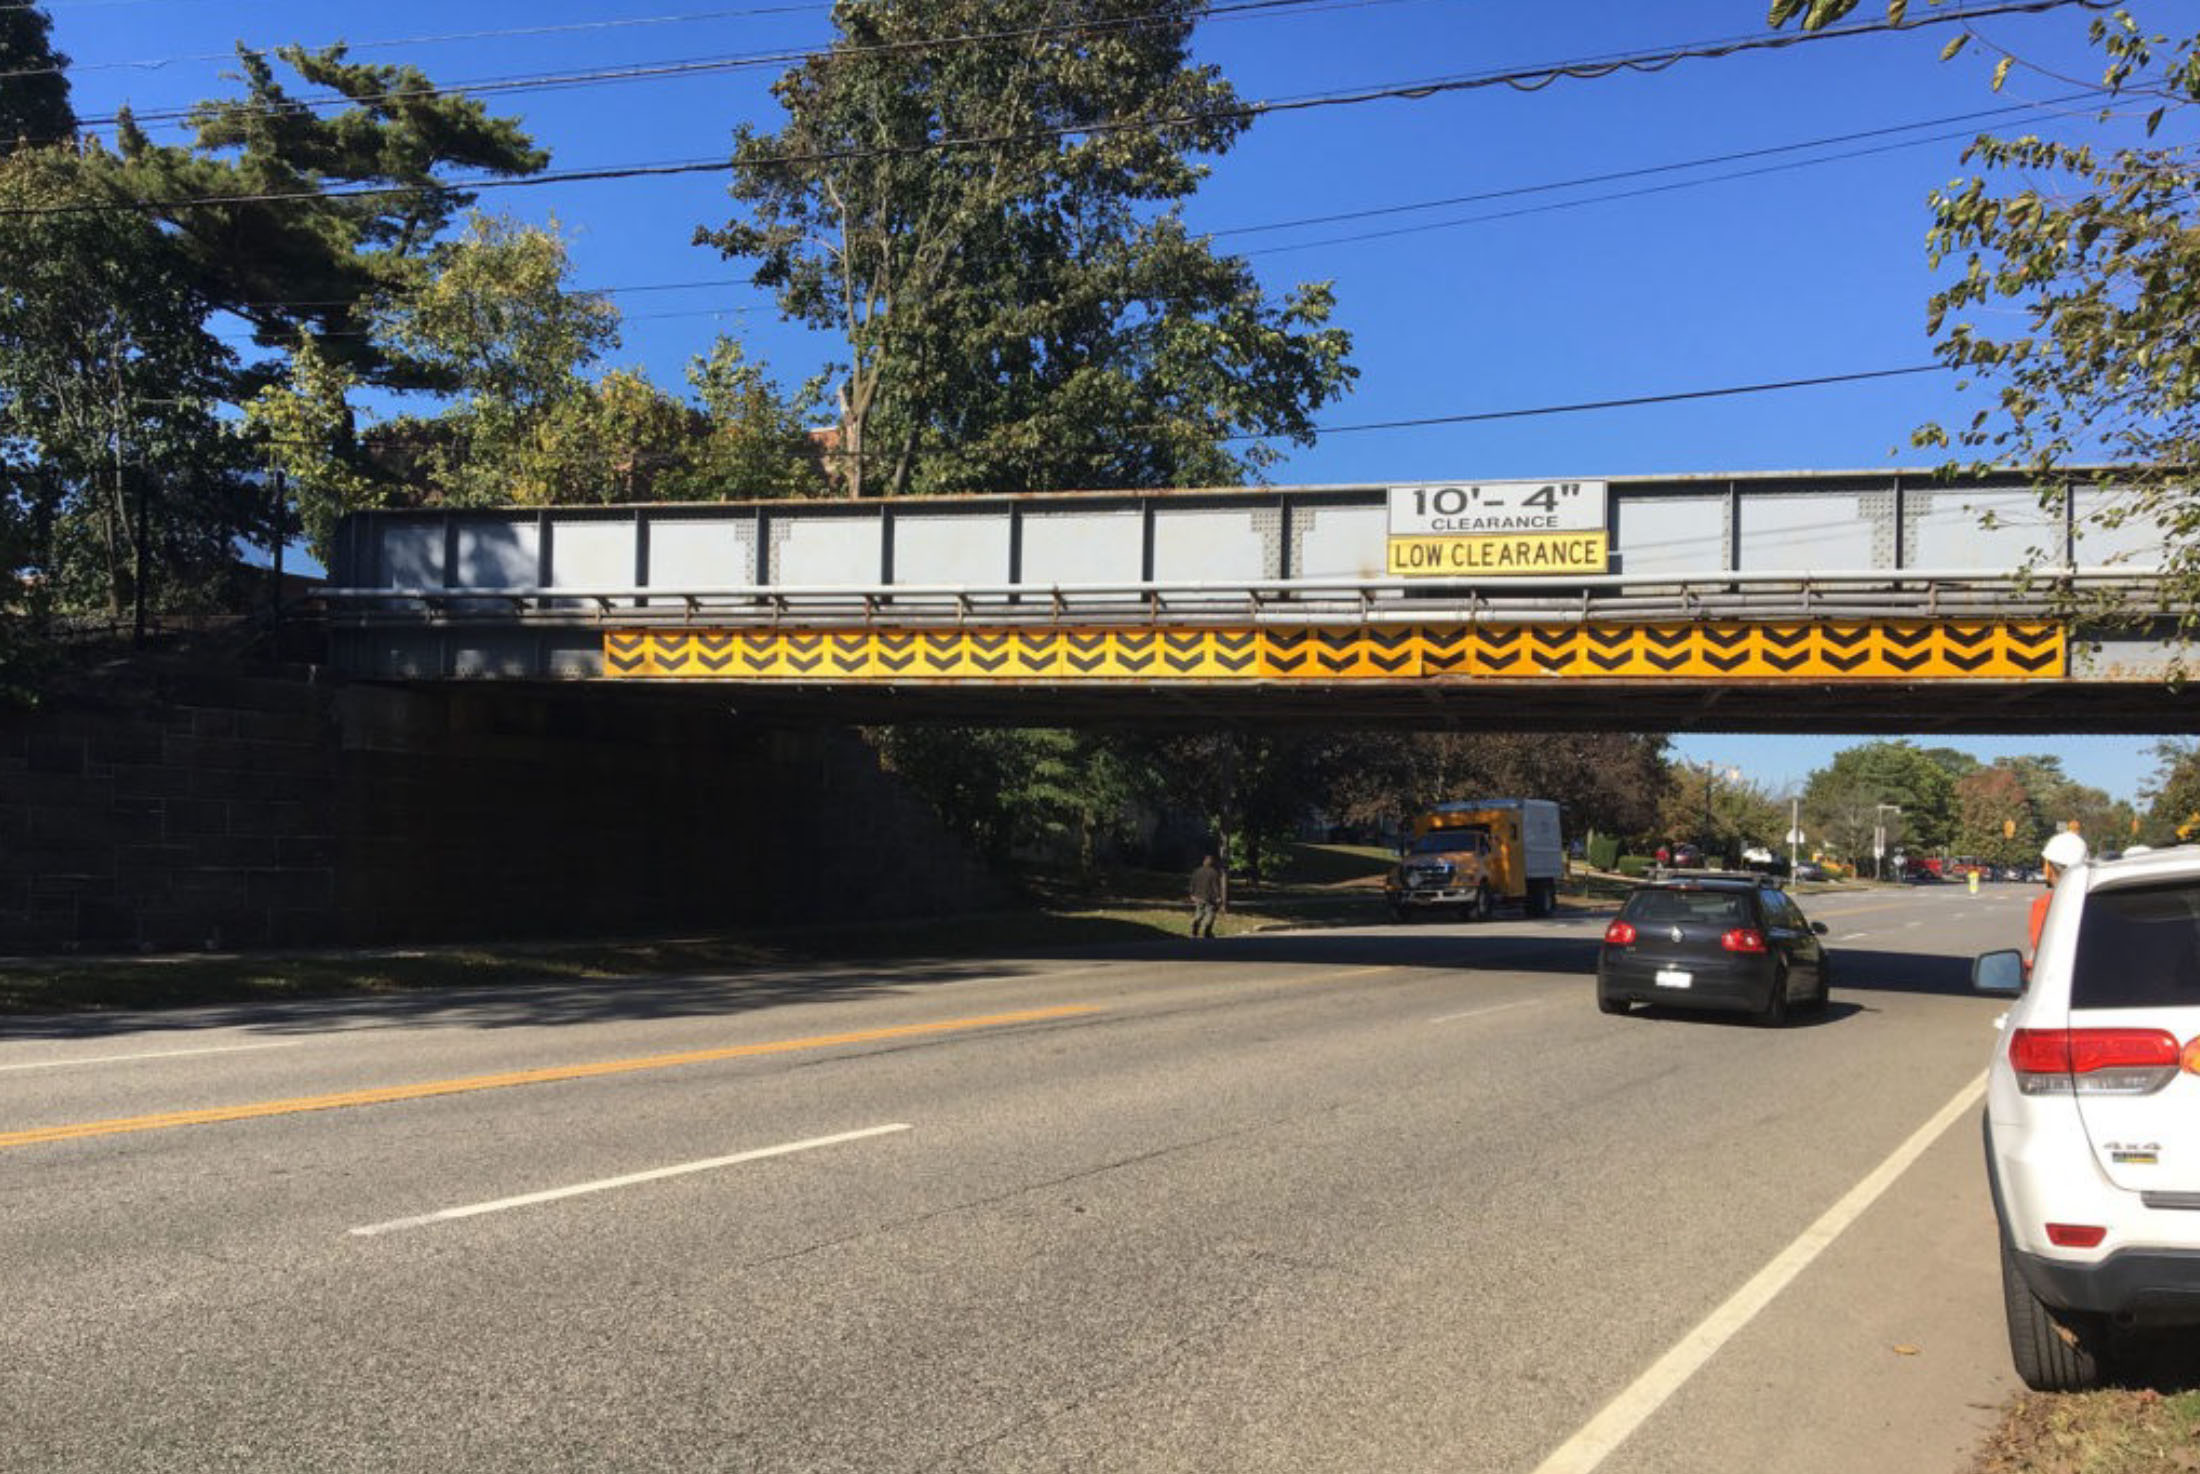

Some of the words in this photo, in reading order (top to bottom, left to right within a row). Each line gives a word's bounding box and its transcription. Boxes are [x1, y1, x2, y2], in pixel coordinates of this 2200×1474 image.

[1431, 515, 1560, 531] CLEARANCE
[1395, 543, 1443, 568] LOW
[1451, 539, 1598, 567] CLEARANCE
